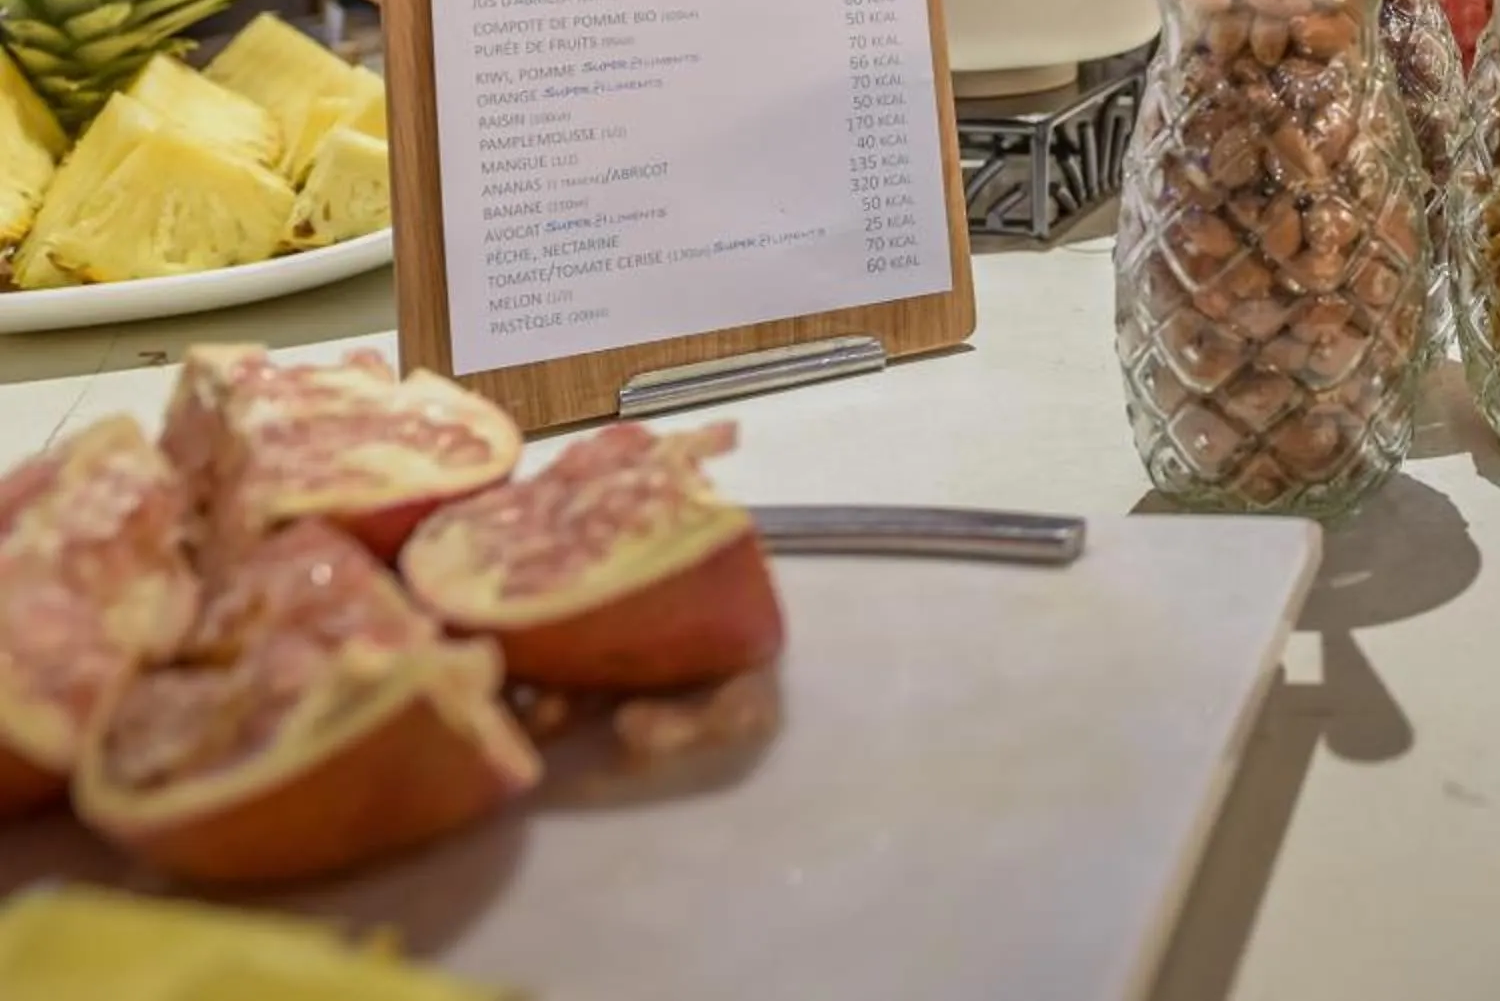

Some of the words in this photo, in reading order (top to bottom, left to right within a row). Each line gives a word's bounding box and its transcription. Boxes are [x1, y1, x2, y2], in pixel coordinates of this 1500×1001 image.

[473, 19, 544, 37] COMPOTE
[549, 15, 568, 30] DE
[573, 12, 629, 28] POMME
[633, 9, 658, 24] BIO
[474, 39, 519, 58] PURÉE
[525, 40, 543, 55] DE
[549, 36, 597, 52] FRUITS
[845, 10, 864, 26] 50
[475, 69, 513, 85] KIWI,
[519, 65, 576, 82] POMME
[848, 34, 867, 50] 70
[476, 89, 537, 109] ORANGE
[478, 113, 526, 130] RAISIN
[850, 74, 870, 91] 70
[479, 128, 596, 151] PAMPLEMOUSSE
[852, 93, 872, 110] 50
[481, 155, 548, 175] MANGUE
[481, 177, 542, 197] ANANAS
[483, 201, 543, 221] BANANE
[849, 154, 877, 173] 135
[484, 222, 542, 244] AVOCAT
[849, 175, 879, 193] 320
[543, 234, 621, 259] NECTARINE
[862, 194, 881, 213] 50
[488, 257, 613, 290] TOMATE/TOMATE
[617, 249, 663, 270] CERISE
[865, 216, 883, 233] 25
[488, 293, 543, 313] MELON
[866, 236, 885, 253] 70
[489, 311, 562, 336] PASTÈQUE
[866, 256, 887, 274] 60
